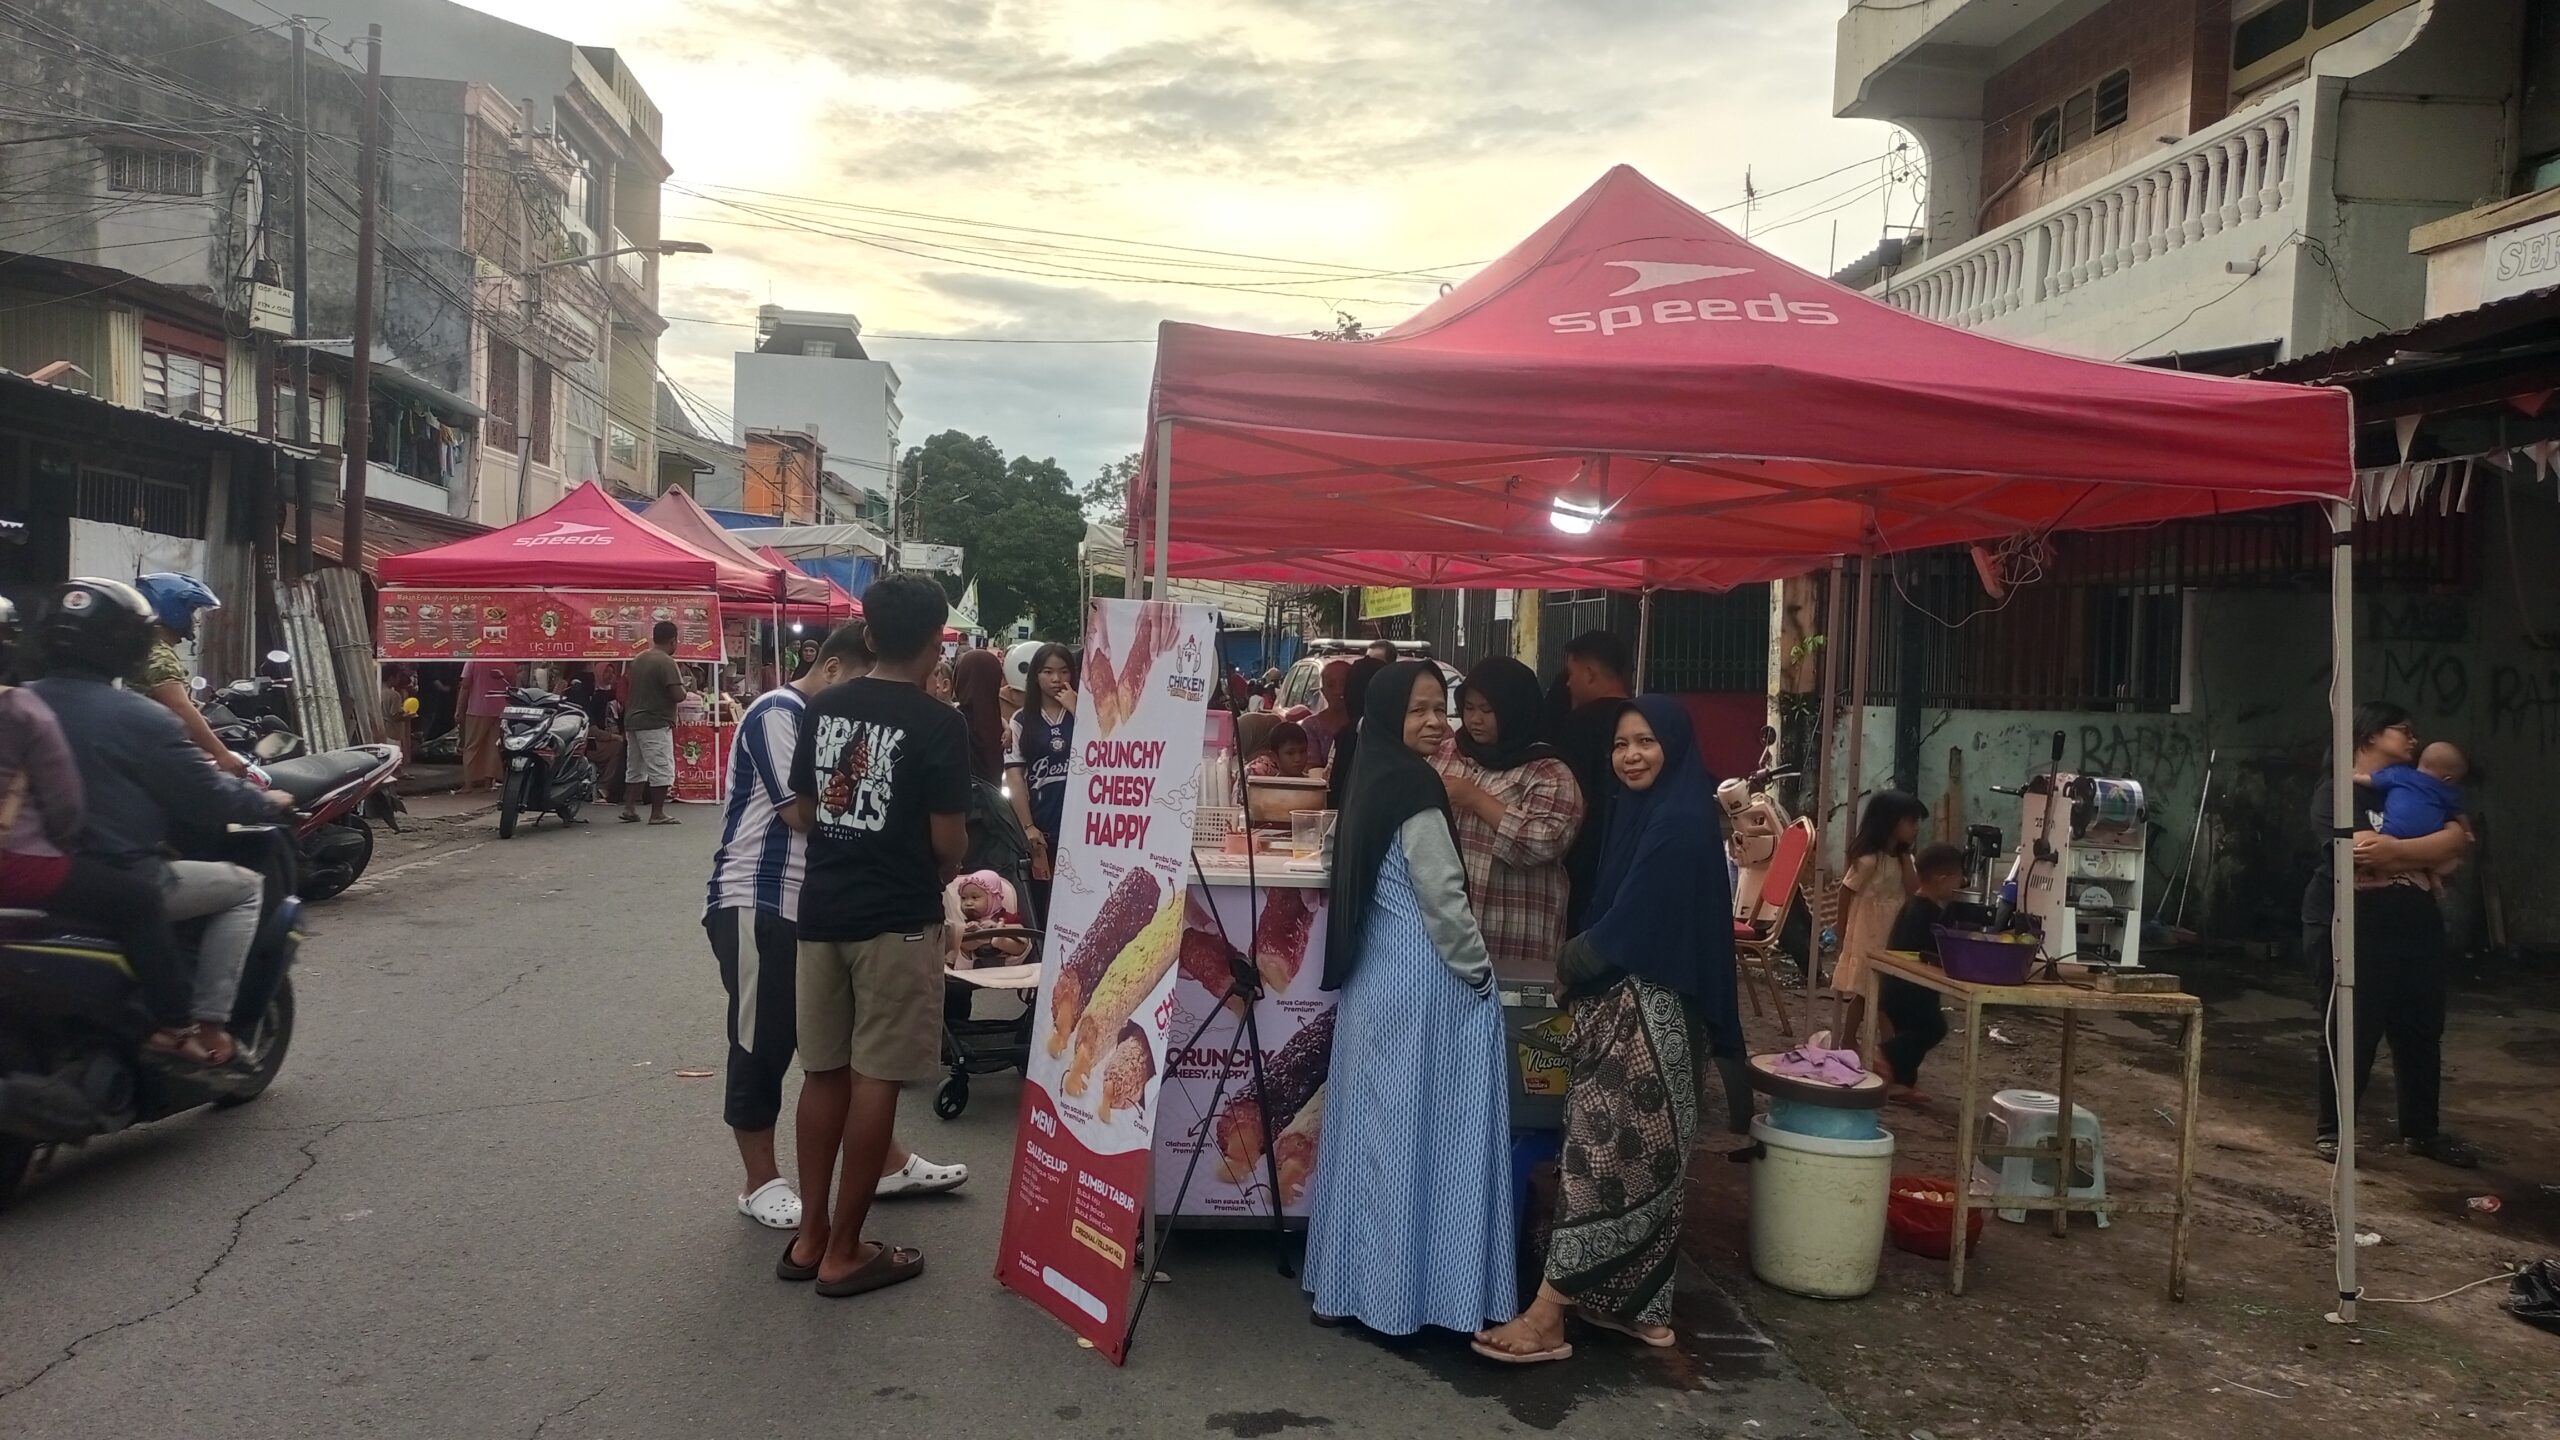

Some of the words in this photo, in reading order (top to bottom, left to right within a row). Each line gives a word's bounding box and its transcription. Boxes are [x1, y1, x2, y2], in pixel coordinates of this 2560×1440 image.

[1548, 292, 1840, 336] speeds
[512, 533, 615, 548] speeds
[1168, 675, 1205, 692] CHICKEN
[1085, 740, 1166, 769] CRUNCHY
[1088, 774, 1156, 808] CHEESY
[1085, 812, 1152, 850] HAPPY
[1155, 862, 1177, 874] Premium
[1030, 1104, 1056, 1138] MENU
[1064, 1110, 1086, 1124] Premium
[1026, 1140, 1042, 1161] SAUS
[1042, 1152, 1068, 1174] CELUP
[1079, 1170, 1108, 1196] BUMBU
[1108, 1186, 1135, 1214] TABUR
[1019, 1260, 1040, 1277] Pesanan
[1020, 1250, 1036, 1267] Terima
